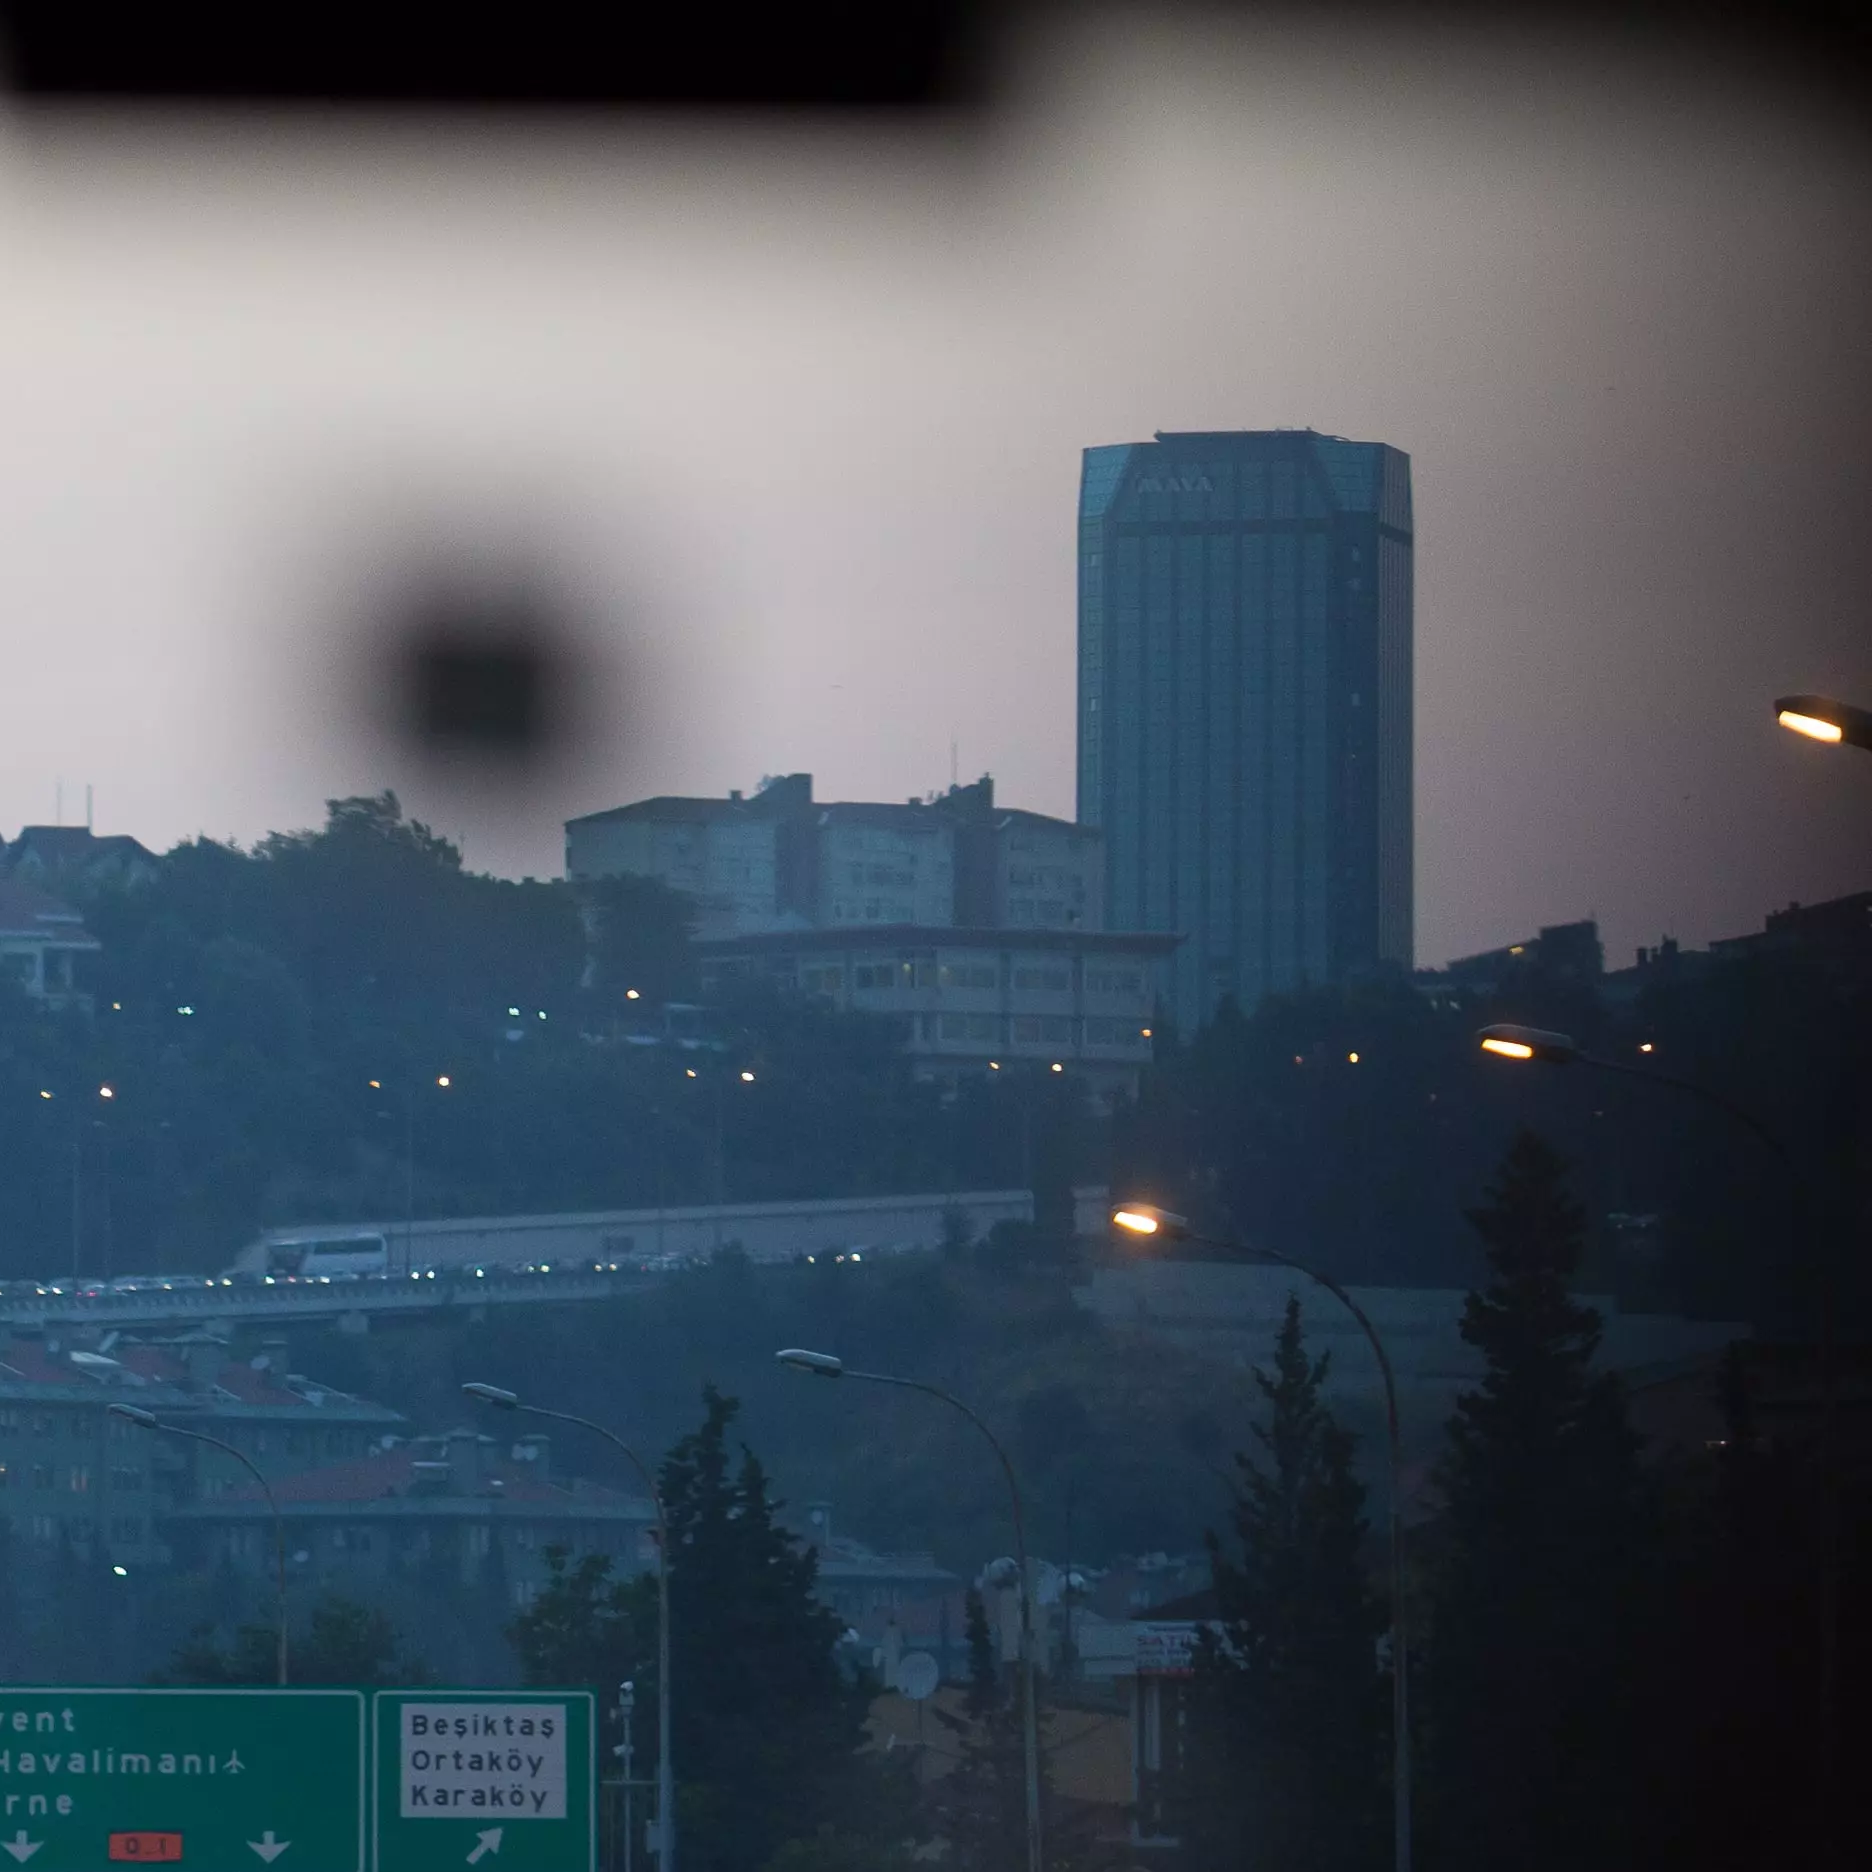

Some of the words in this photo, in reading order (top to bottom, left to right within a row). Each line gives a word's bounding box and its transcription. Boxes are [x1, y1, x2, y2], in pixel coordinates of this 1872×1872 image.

[411, 1714, 555, 1739] Beşiktaş
[411, 1748, 544, 1778] Ortaköy
[411, 1784, 548, 1813] Karaköy
